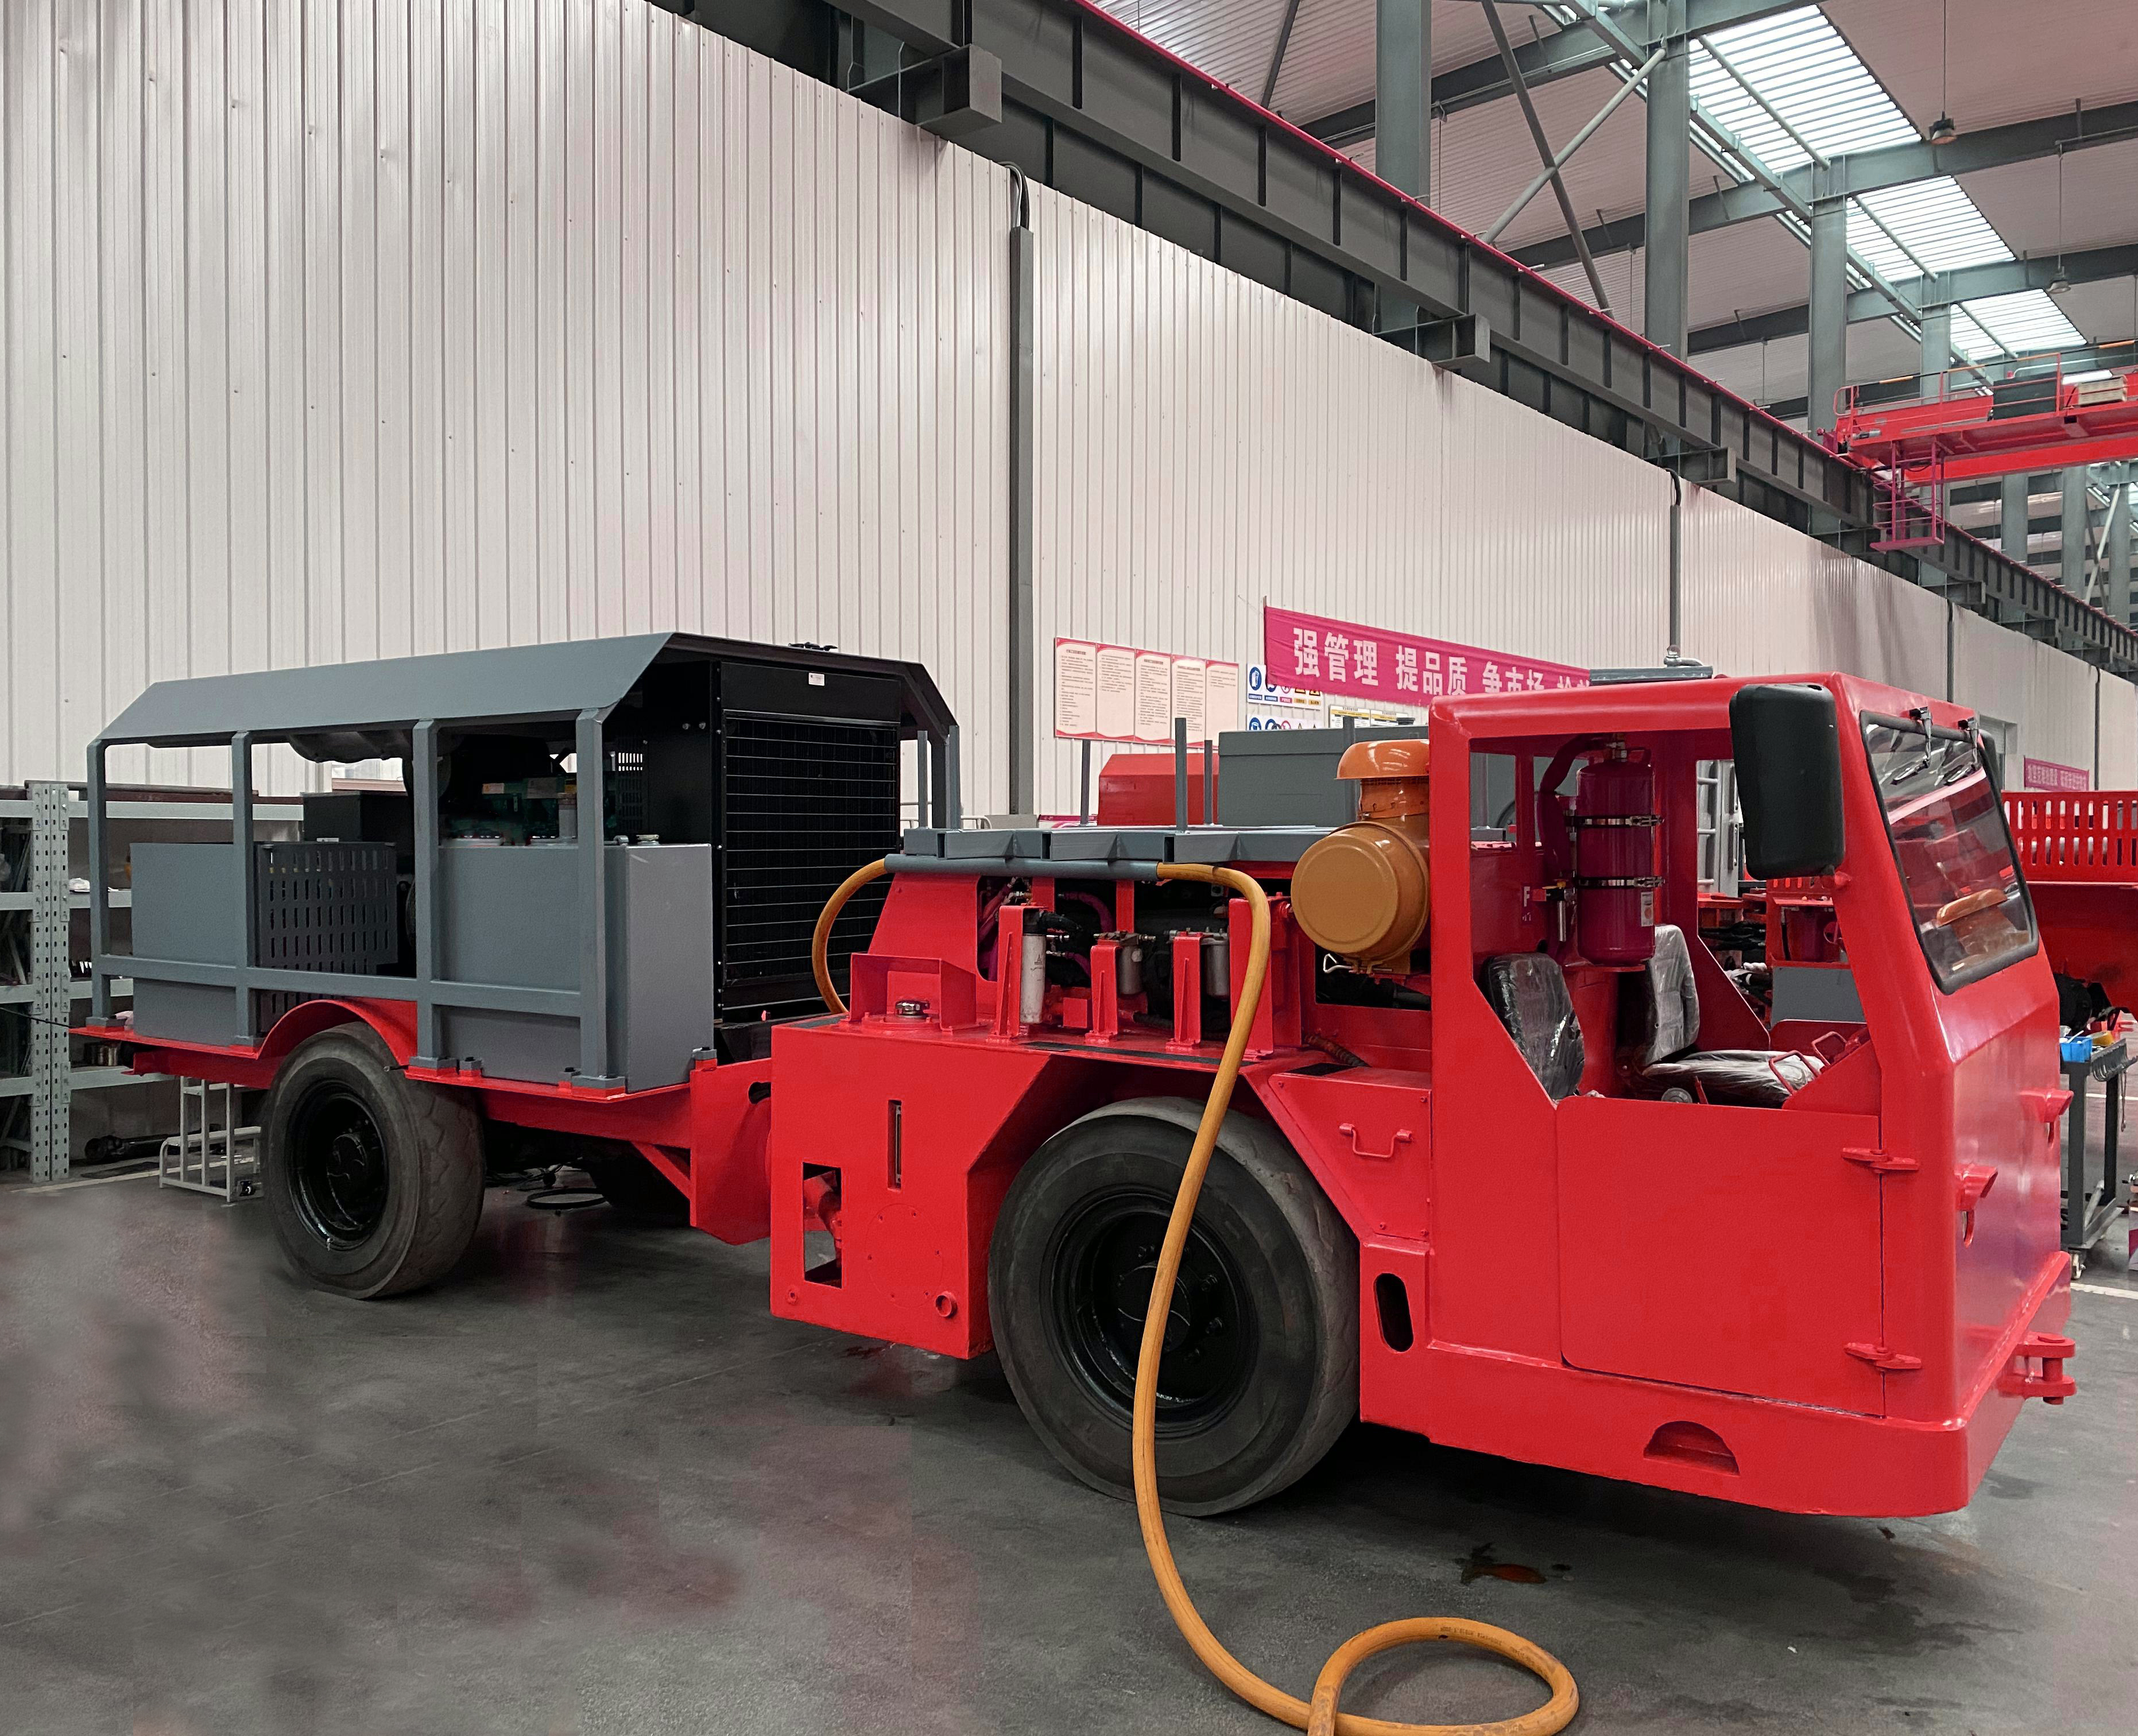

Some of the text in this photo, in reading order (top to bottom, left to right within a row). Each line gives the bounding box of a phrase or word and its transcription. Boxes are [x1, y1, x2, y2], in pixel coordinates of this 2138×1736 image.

[1293, 627, 1378, 686] 强管理
[1396, 645, 1467, 696] 提品质
